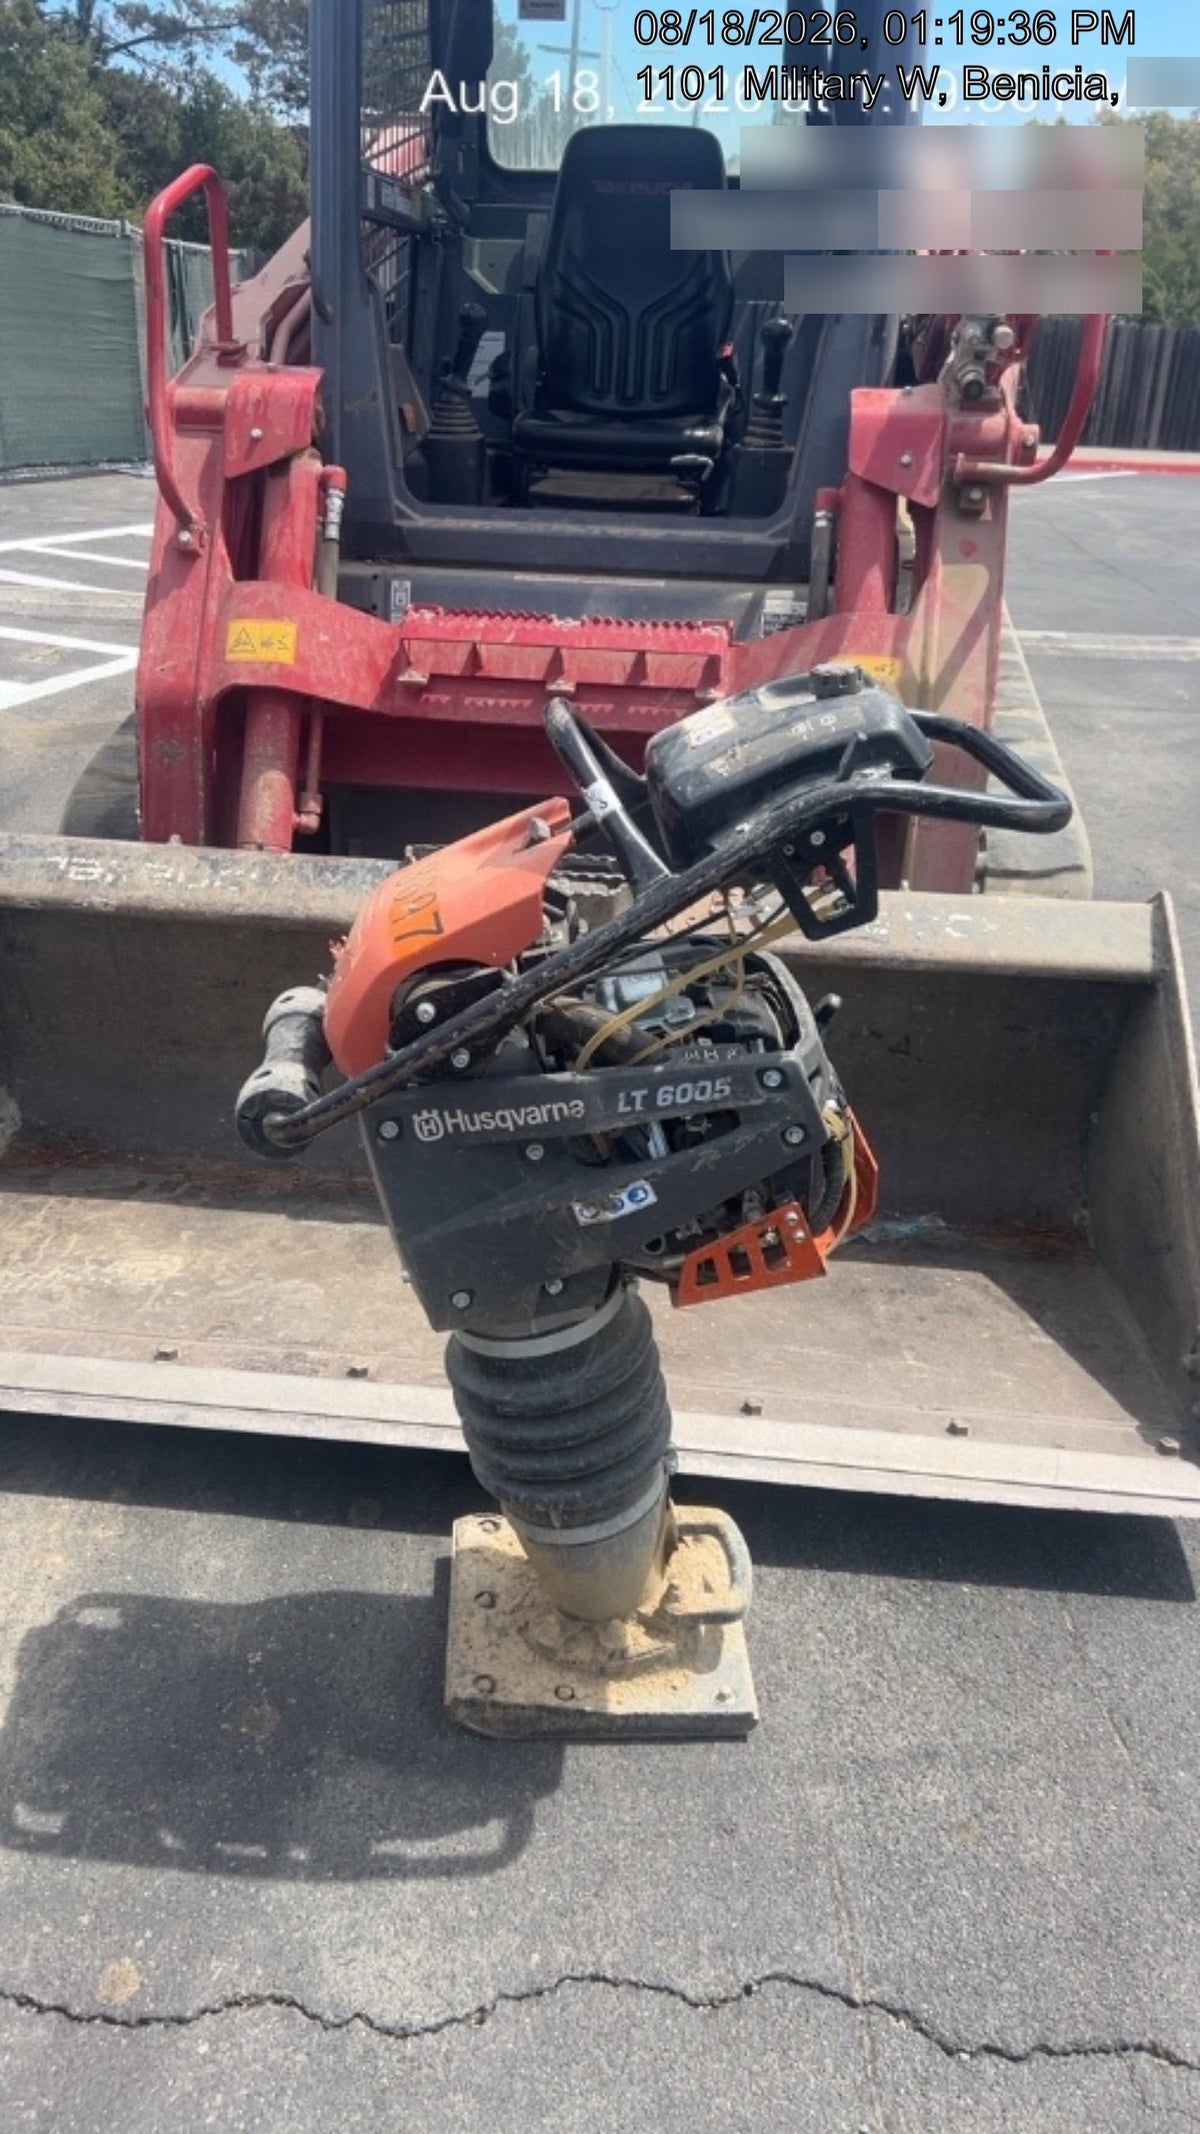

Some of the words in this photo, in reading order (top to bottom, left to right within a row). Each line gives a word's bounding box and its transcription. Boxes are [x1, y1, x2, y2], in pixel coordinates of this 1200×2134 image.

[617, 1089, 648, 1113] LT
[656, 1077, 731, 1107] 6005
[446, 1099, 585, 1134] Husqvarna
